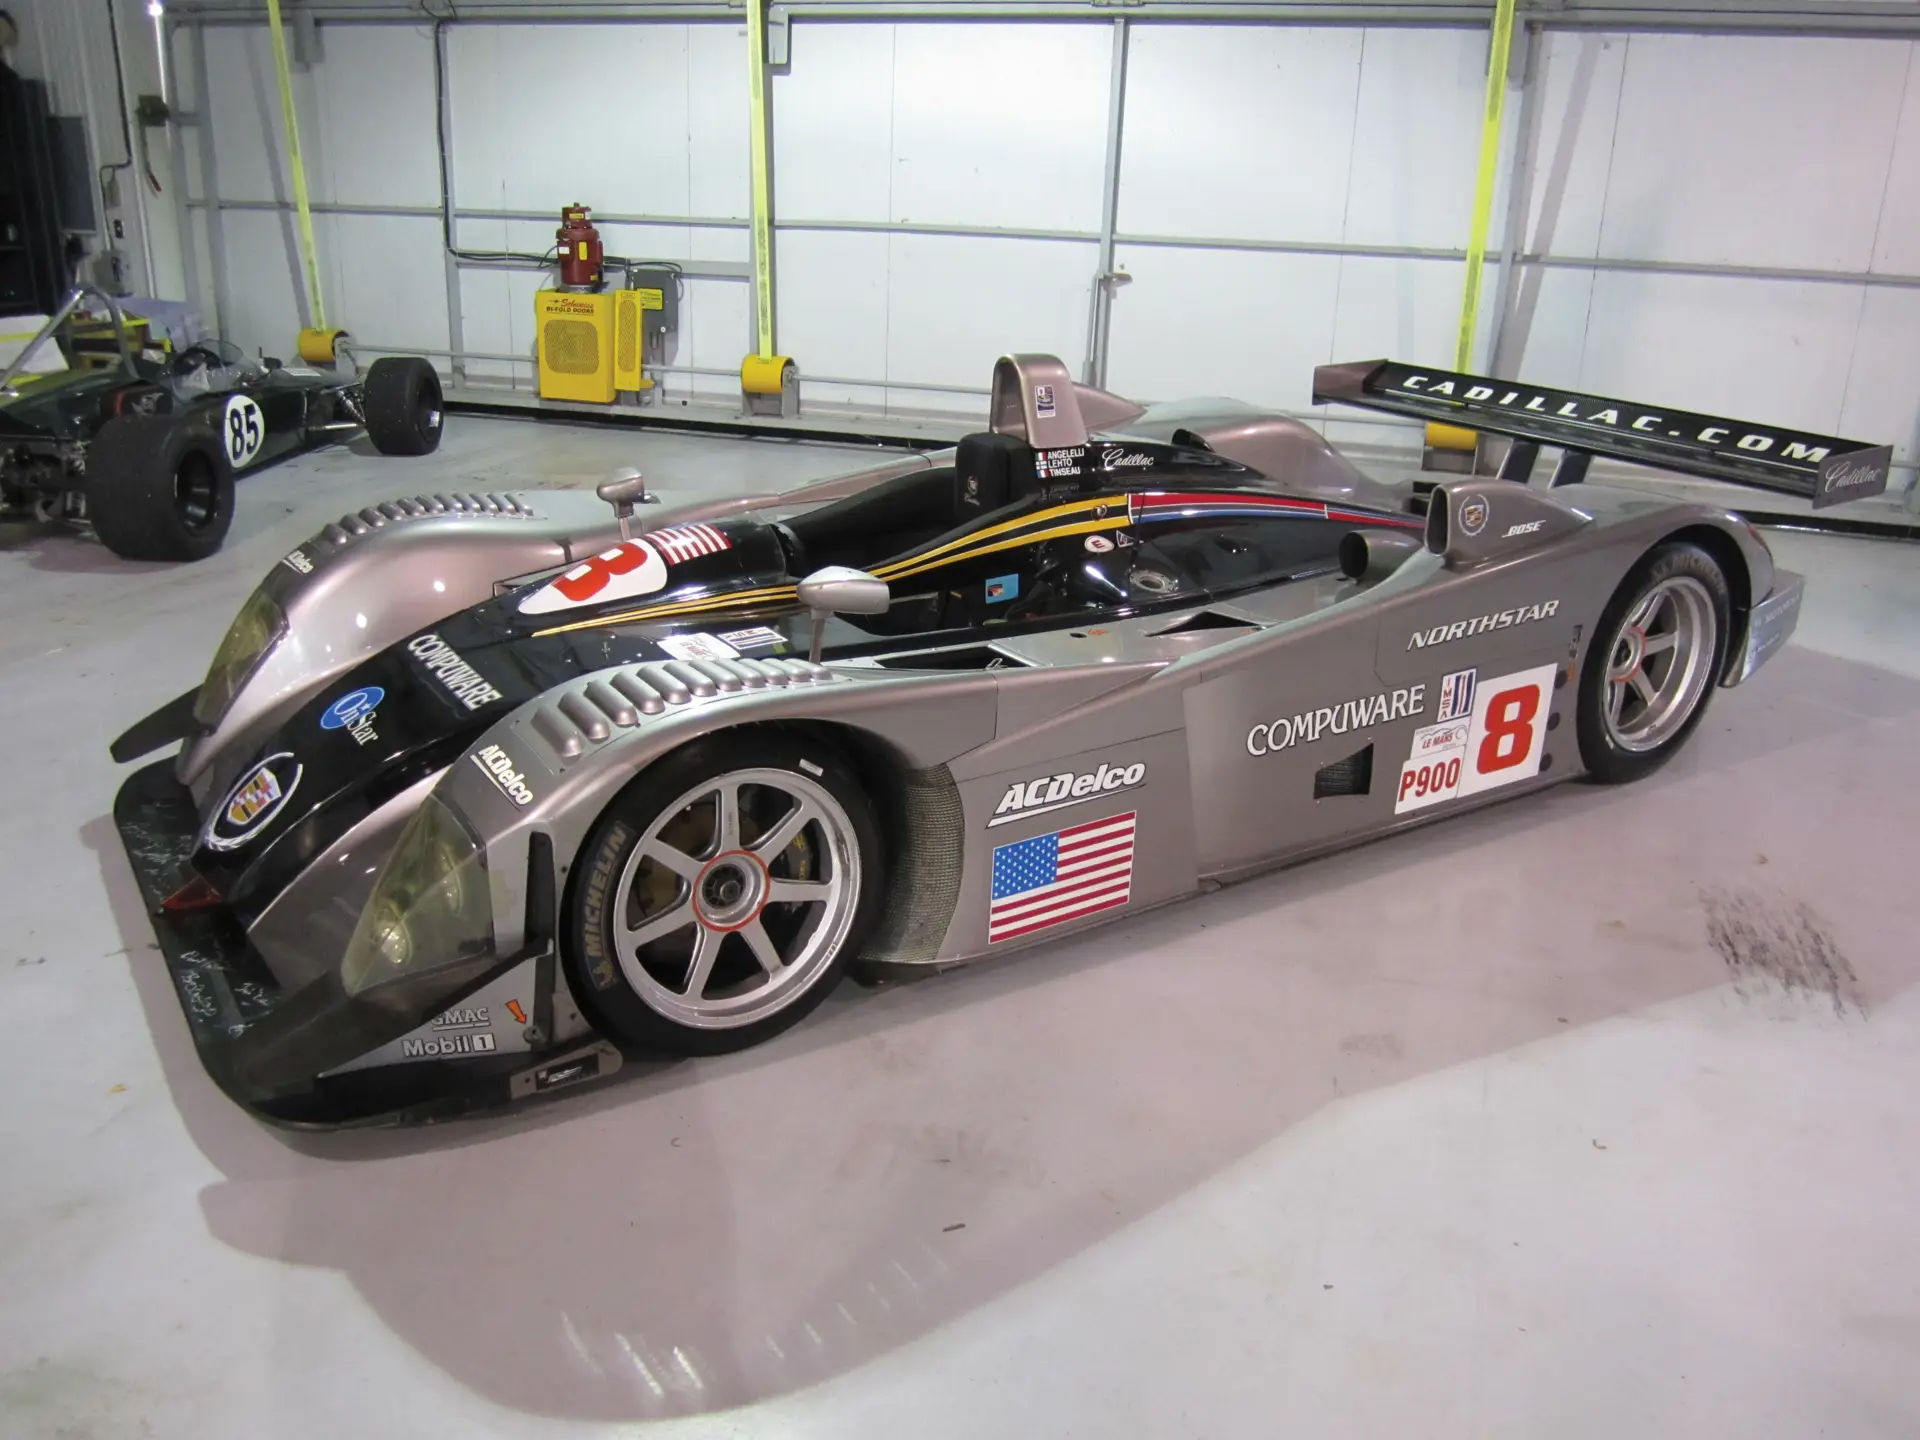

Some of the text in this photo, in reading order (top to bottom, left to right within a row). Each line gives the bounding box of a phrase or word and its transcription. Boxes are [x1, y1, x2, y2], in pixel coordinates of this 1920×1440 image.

[229, 403, 260, 461] 85
[1402, 375, 1831, 463] CADILLAC.COM
[1047, 448, 1085, 460] ANGELELLI
[1048, 458, 1073, 469] LEHTO
[1048, 466, 1081, 478] TINSEAU
[1102, 448, 1154, 468] Cadillac
[1824, 461, 1882, 493] Cadillac
[1501, 520, 1546, 538] BOSE
[551, 542, 649, 602] 8
[1406, 600, 1560, 651] NORTHSTAR
[407, 634, 503, 711] COMPUWARE
[334, 692, 379, 746] OnStar
[1246, 684, 1426, 757] COMPUWARE
[1441, 677, 1452, 719] IMSA
[1422, 737, 1433, 749] LE
[1432, 731, 1454, 745] MANS
[1476, 683, 1541, 775] 8
[478, 744, 534, 806] ACDelco
[993, 762, 1147, 815] ACDelco
[1398, 757, 1461, 803] P900
[584, 825, 629, 957] MICHELIN
[431, 1007, 489, 1025] GMAC
[402, 1034, 470, 1057] Mobil
